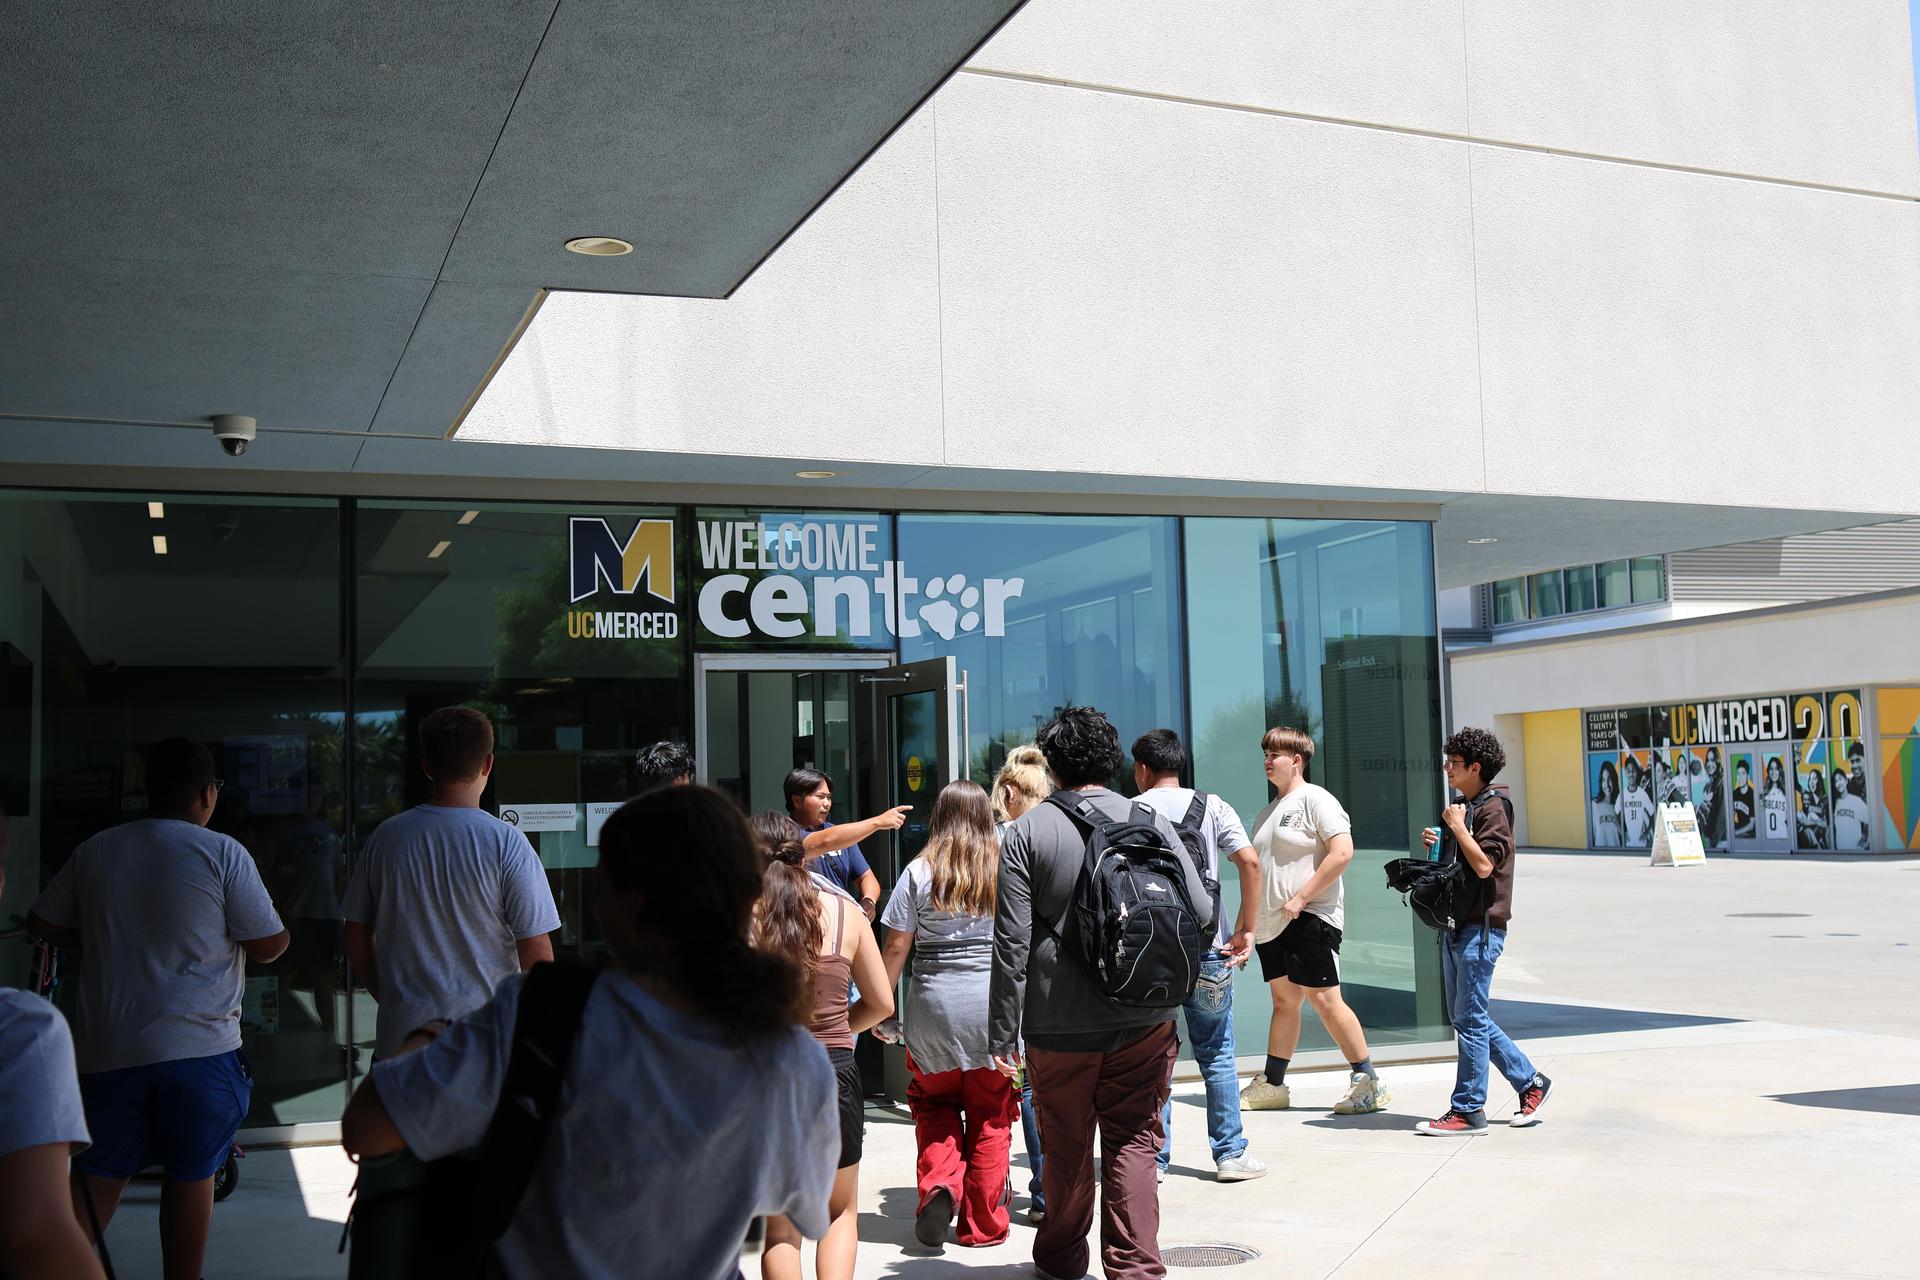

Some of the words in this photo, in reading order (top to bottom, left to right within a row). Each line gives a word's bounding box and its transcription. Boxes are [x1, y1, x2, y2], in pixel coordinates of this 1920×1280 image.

[697, 520, 879, 571] WELCOME
[698, 560, 1025, 640] centr
[567, 611, 678, 639] UCMERCED
[1590, 711, 1628, 722] CELEBRATNG
[1590, 722, 1613, 731] TWENTY
[1591, 731, 1607, 740] YEARS
[1671, 698, 1788, 746] UCMERCED
[1794, 692, 1864, 779] 20
[1591, 740, 1609, 749] FIRSTS
